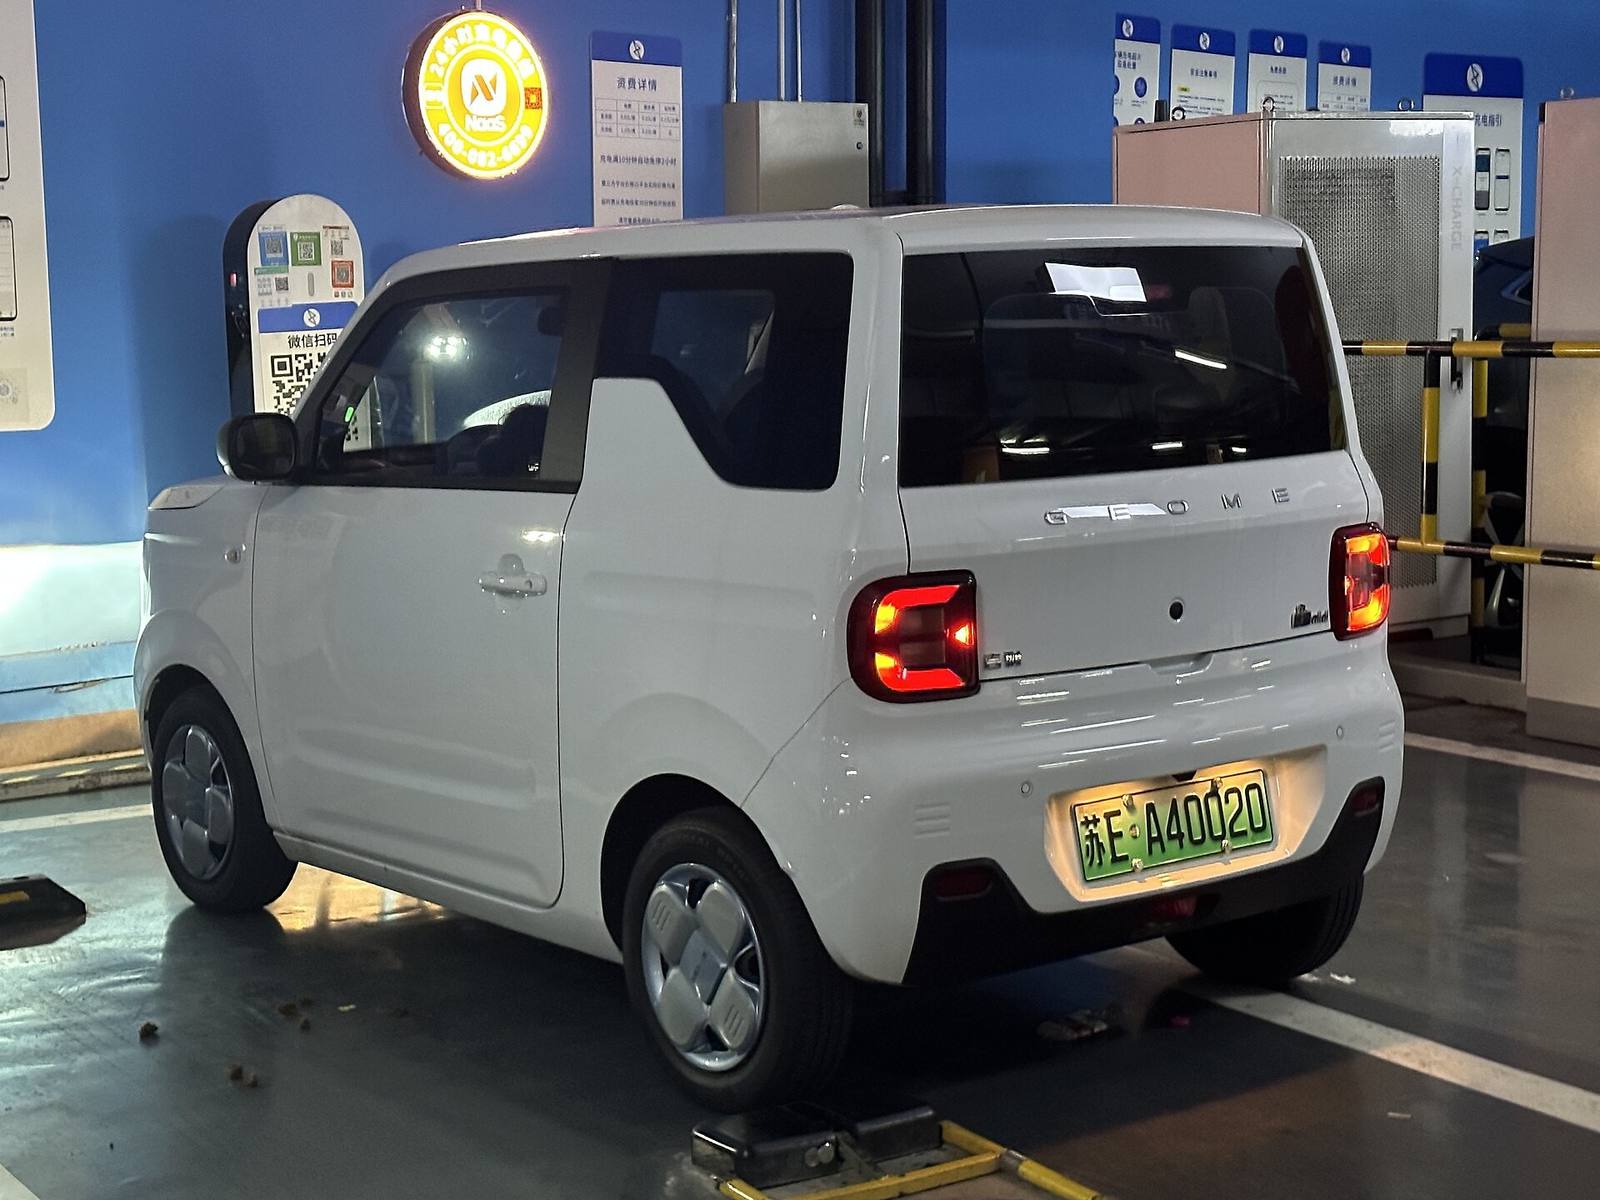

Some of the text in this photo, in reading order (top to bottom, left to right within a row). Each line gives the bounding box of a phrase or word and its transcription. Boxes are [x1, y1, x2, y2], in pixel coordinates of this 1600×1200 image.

[617, 77, 657, 92] 资费详情
[287, 333, 337, 349] 微信扫码
[1044, 487, 1291, 525] GEOME
